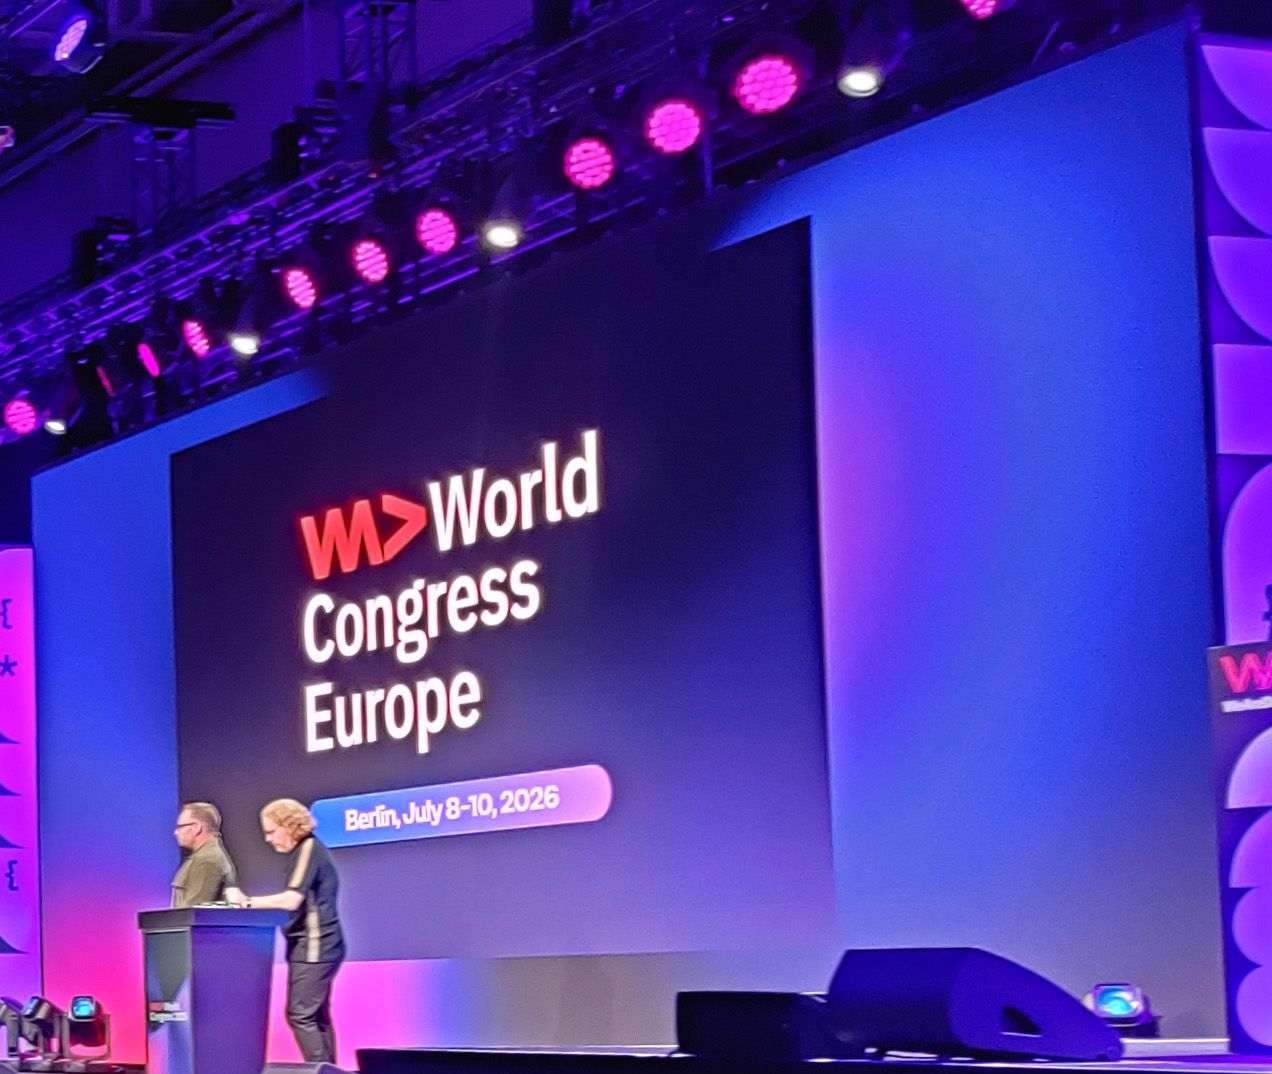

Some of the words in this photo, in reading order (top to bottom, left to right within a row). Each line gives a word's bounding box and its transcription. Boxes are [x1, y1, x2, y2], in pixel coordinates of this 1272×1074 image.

[427, 429, 600, 552] World
[302, 559, 541, 664] Congress
[304, 670, 482, 754] Europe
[345, 803, 401, 832] Berlin,
[402, 798, 443, 827] July
[445, 792, 498, 820] 8-10,
[500, 785, 560, 814] 2026
